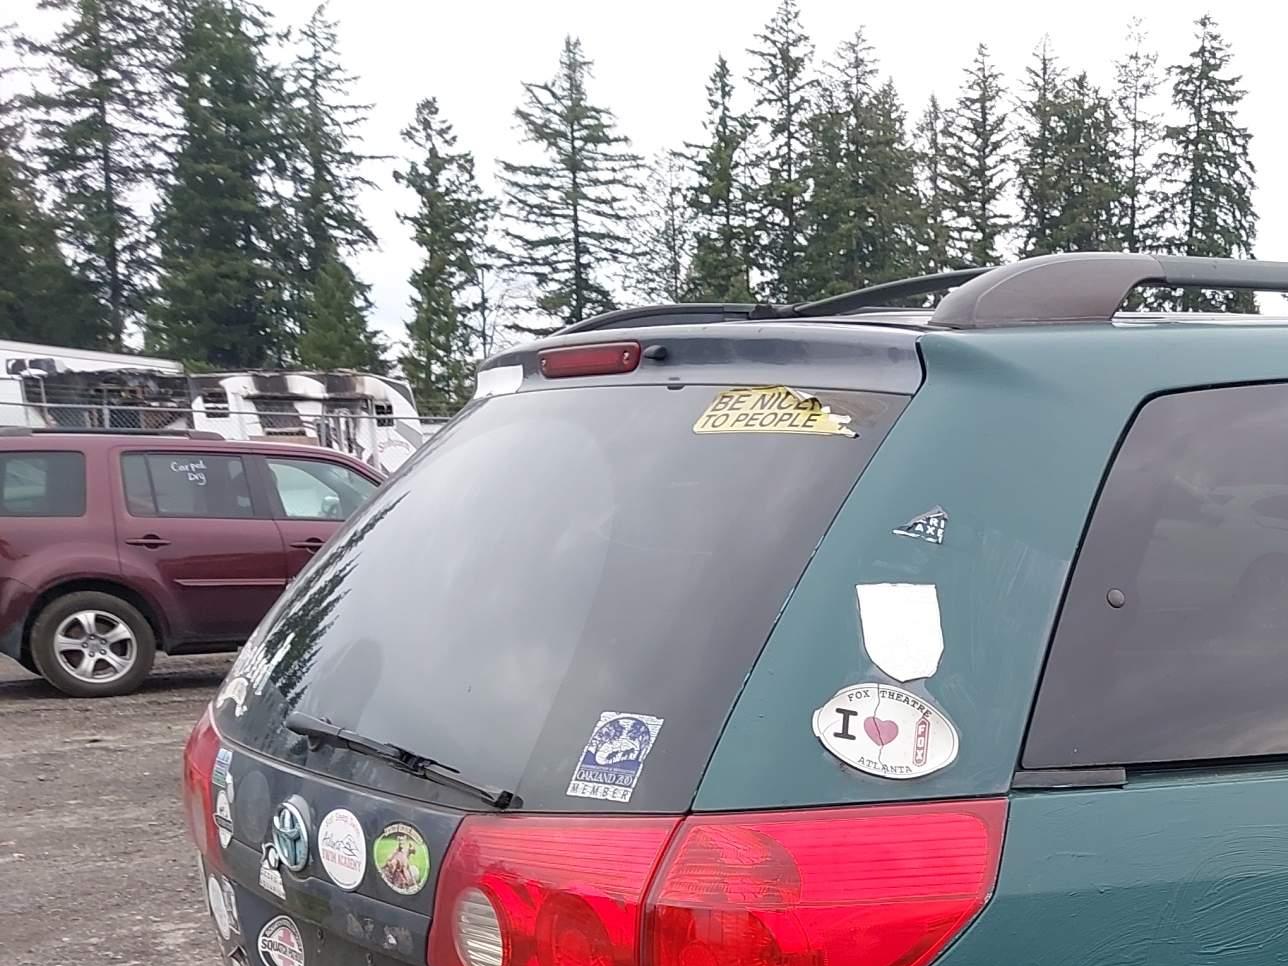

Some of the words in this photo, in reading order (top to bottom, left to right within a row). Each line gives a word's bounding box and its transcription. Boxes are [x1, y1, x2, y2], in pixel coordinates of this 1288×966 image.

[710, 393, 752, 412] BE
[700, 413, 730, 429] TO
[730, 412, 821, 428] PEOPLE
[847, 689, 871, 702] FOX
[880, 690, 933, 719] THEATRE
[833, 707, 859, 741] I
[915, 724, 927, 764] FOX
[857, 756, 913, 775] ATLANTA
[576, 769, 616, 784] OAKLAND
[570, 782, 630, 801] MEMBER
